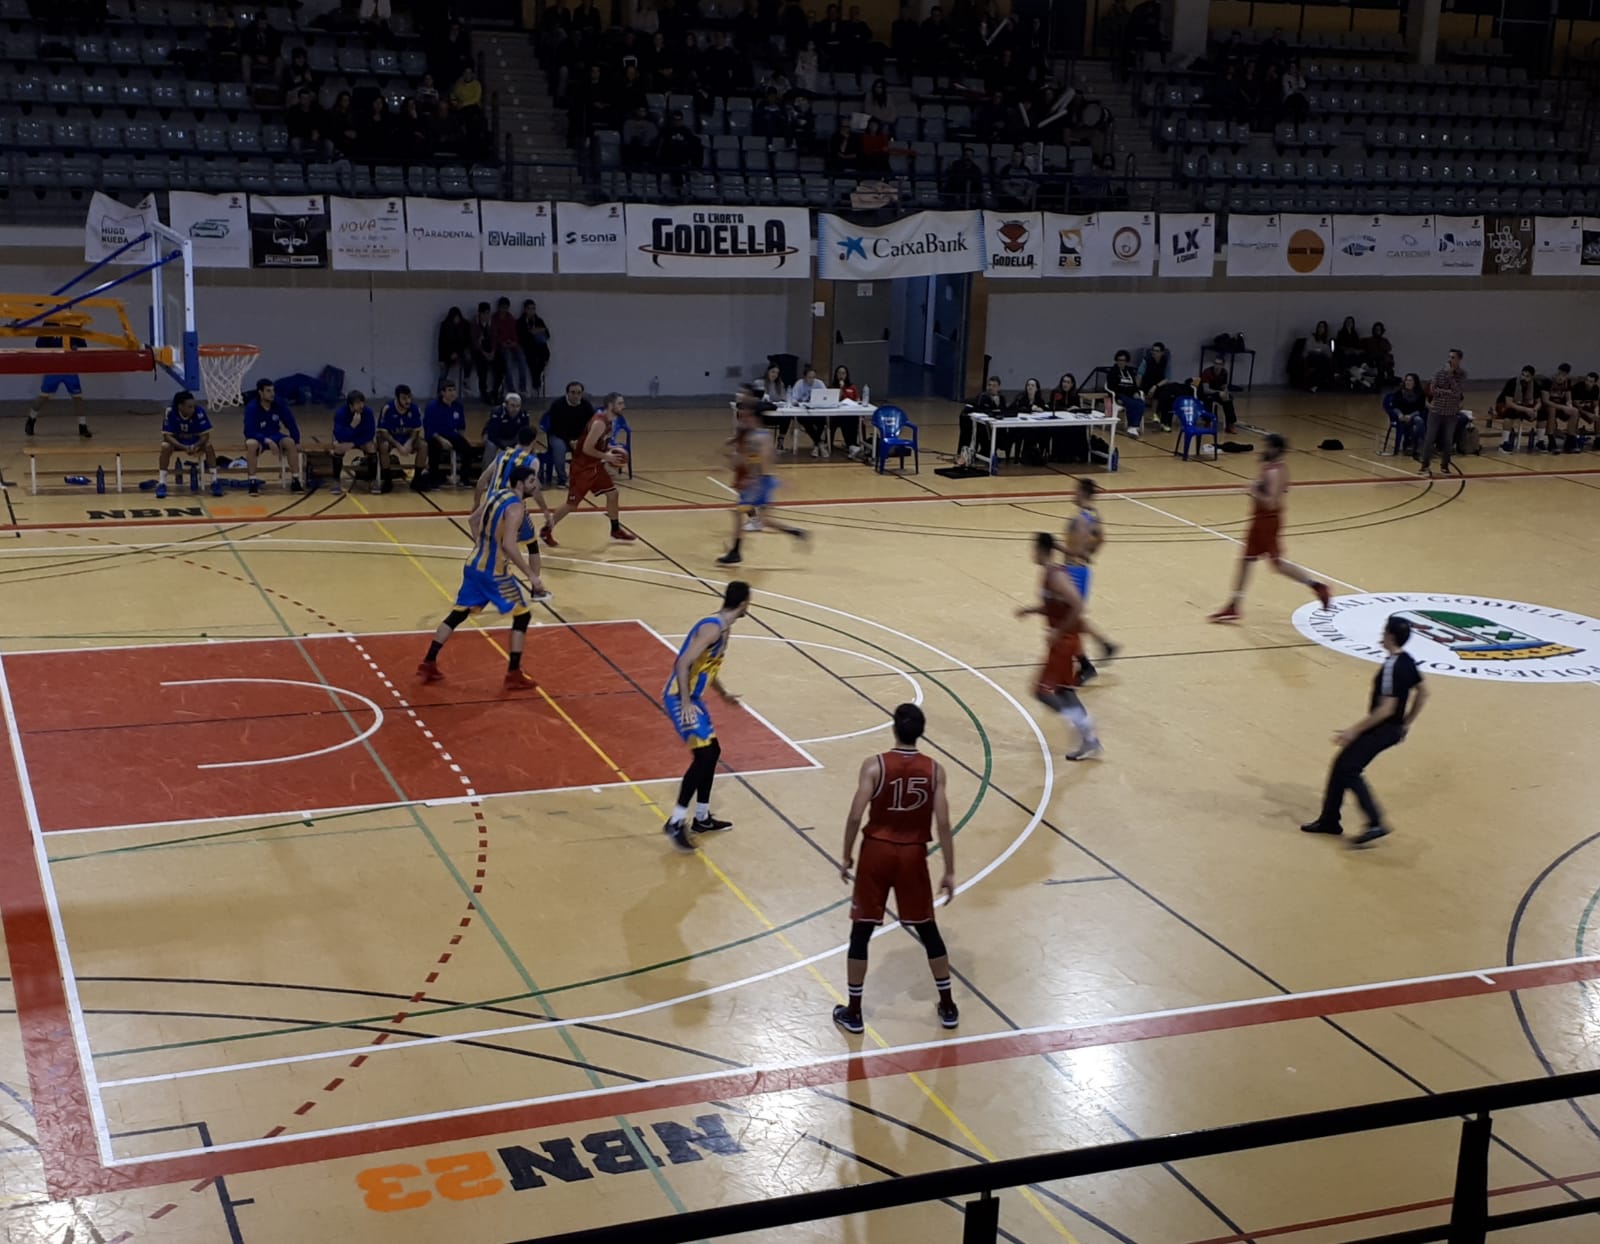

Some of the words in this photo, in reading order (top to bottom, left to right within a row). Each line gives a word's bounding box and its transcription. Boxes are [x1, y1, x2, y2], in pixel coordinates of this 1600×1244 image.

[693, 212, 705, 223] CB
[501, 231, 547, 247] Vaillant
[581, 233, 617, 243] sonia
[652, 217, 786, 255] GODELLA
[873, 232, 968, 259] CaixaBank
[1173, 228, 1200, 256] LX
[992, 254, 1034, 267] GODELLA
[887, 777, 928, 811] 15
[356, 1112, 748, 1213] NBN23
